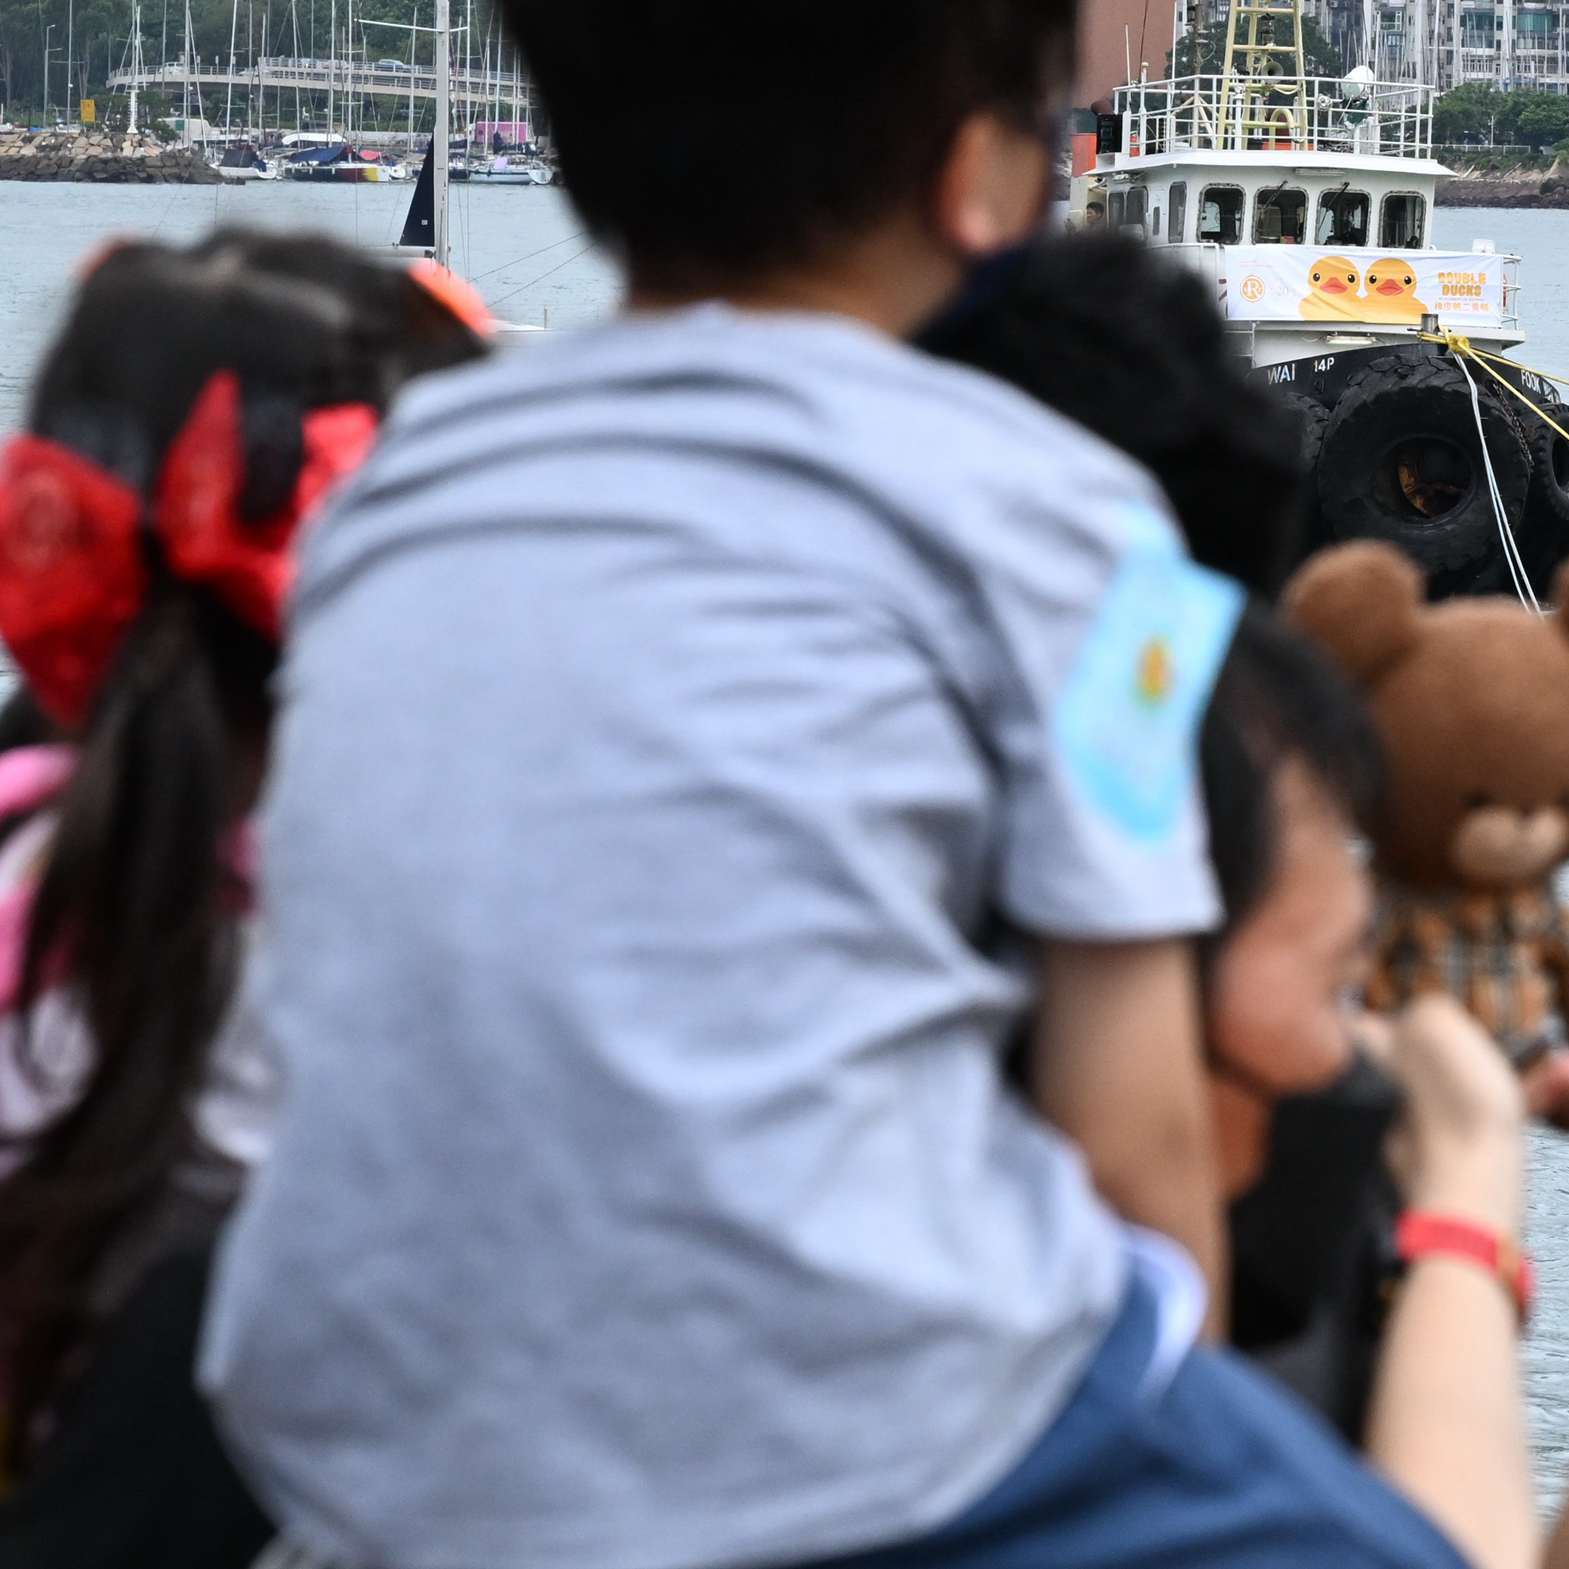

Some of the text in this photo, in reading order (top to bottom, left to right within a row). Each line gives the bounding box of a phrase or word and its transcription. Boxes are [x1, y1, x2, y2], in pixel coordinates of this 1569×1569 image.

[1442, 285, 1481, 296] DUCKS
[1267, 357, 1335, 384] WAI 14P
